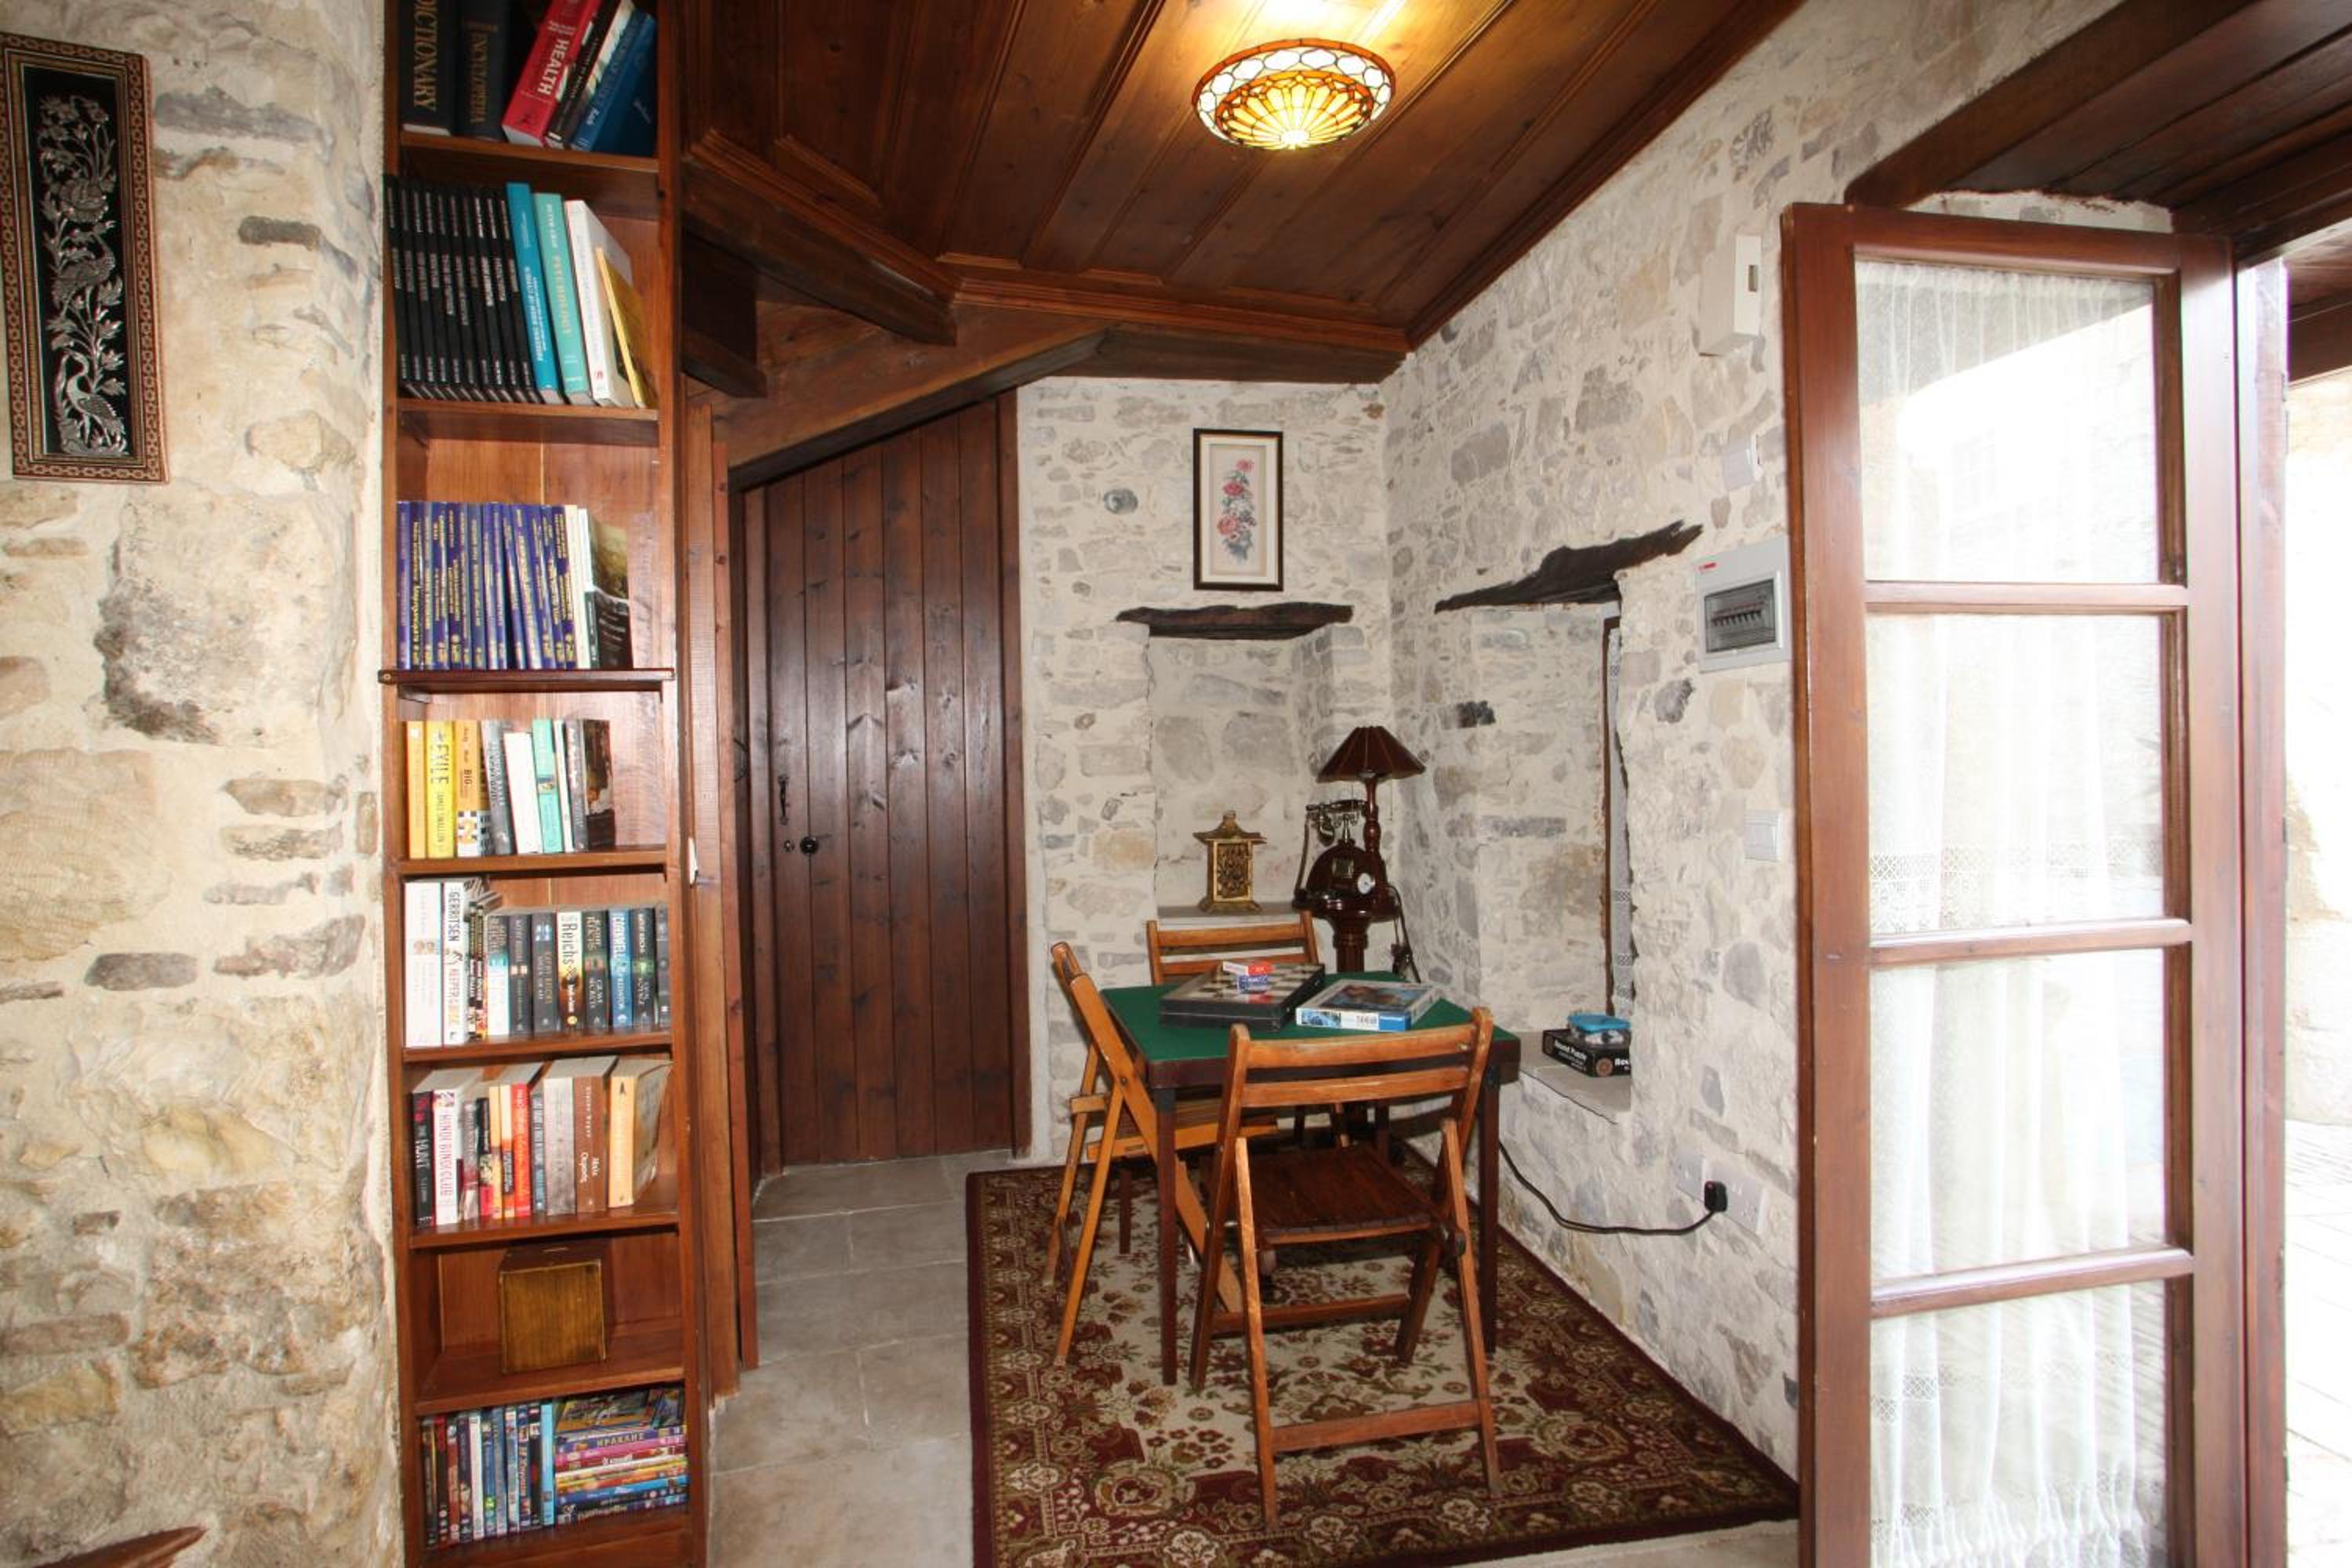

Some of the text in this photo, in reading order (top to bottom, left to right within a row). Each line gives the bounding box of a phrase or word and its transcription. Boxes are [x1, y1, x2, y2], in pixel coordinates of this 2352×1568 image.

[537, 38, 570, 96] HEALTH
[430, 742, 450, 785] EXILE
[448, 891, 461, 942] GERRITSEN
[561, 922, 576, 965] Reichs
